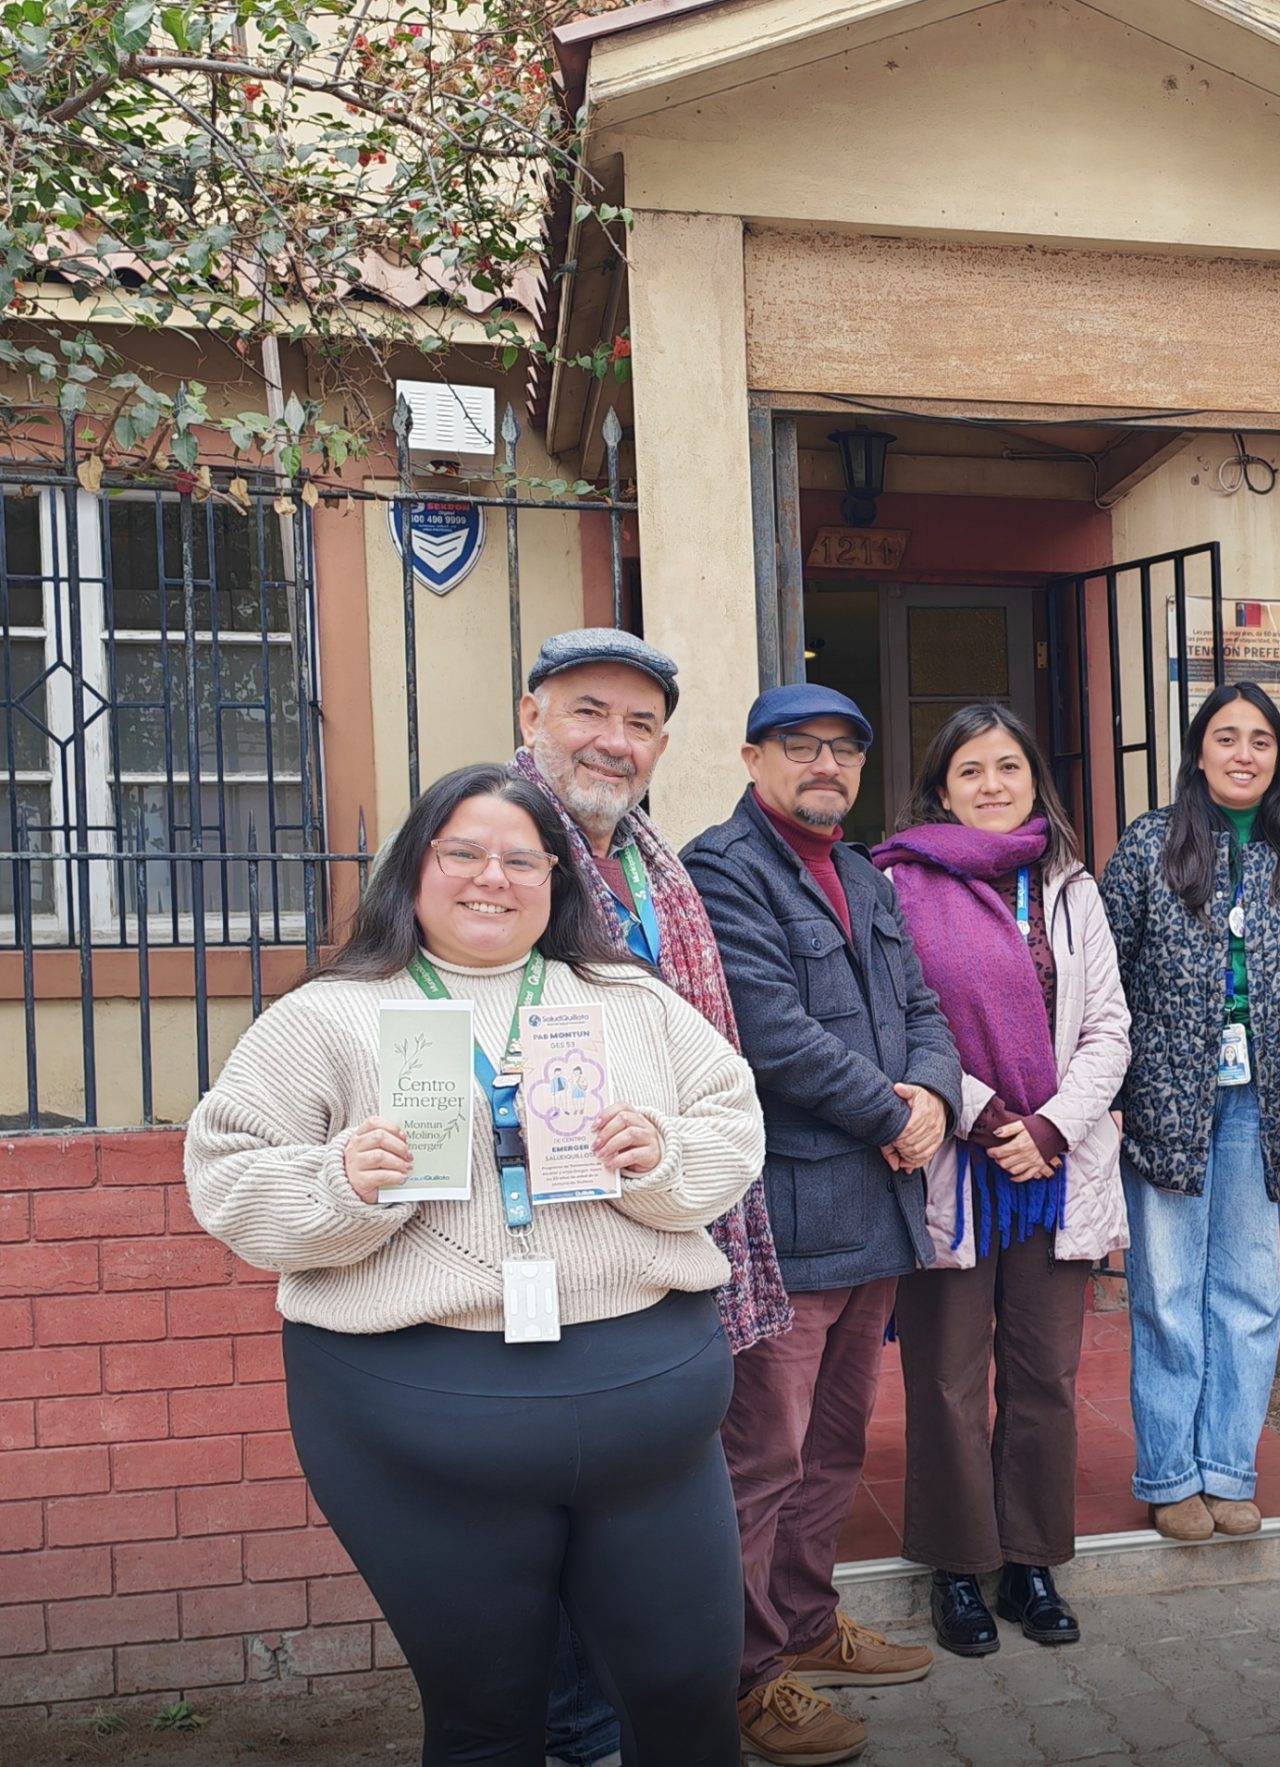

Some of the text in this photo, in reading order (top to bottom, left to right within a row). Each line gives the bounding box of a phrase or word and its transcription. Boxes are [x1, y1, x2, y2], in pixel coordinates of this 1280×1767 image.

[820, 536, 891, 566] 1211
[550, 1030, 590, 1039] MONTUN
[398, 1076, 456, 1092] Centro
[392, 1092, 465, 1111] Emerger
[404, 1119, 443, 1129] Montun
[406, 1130, 440, 1140] Molino
[408, 1141, 443, 1152] merger
[551, 1144, 590, 1152] EMERGER
